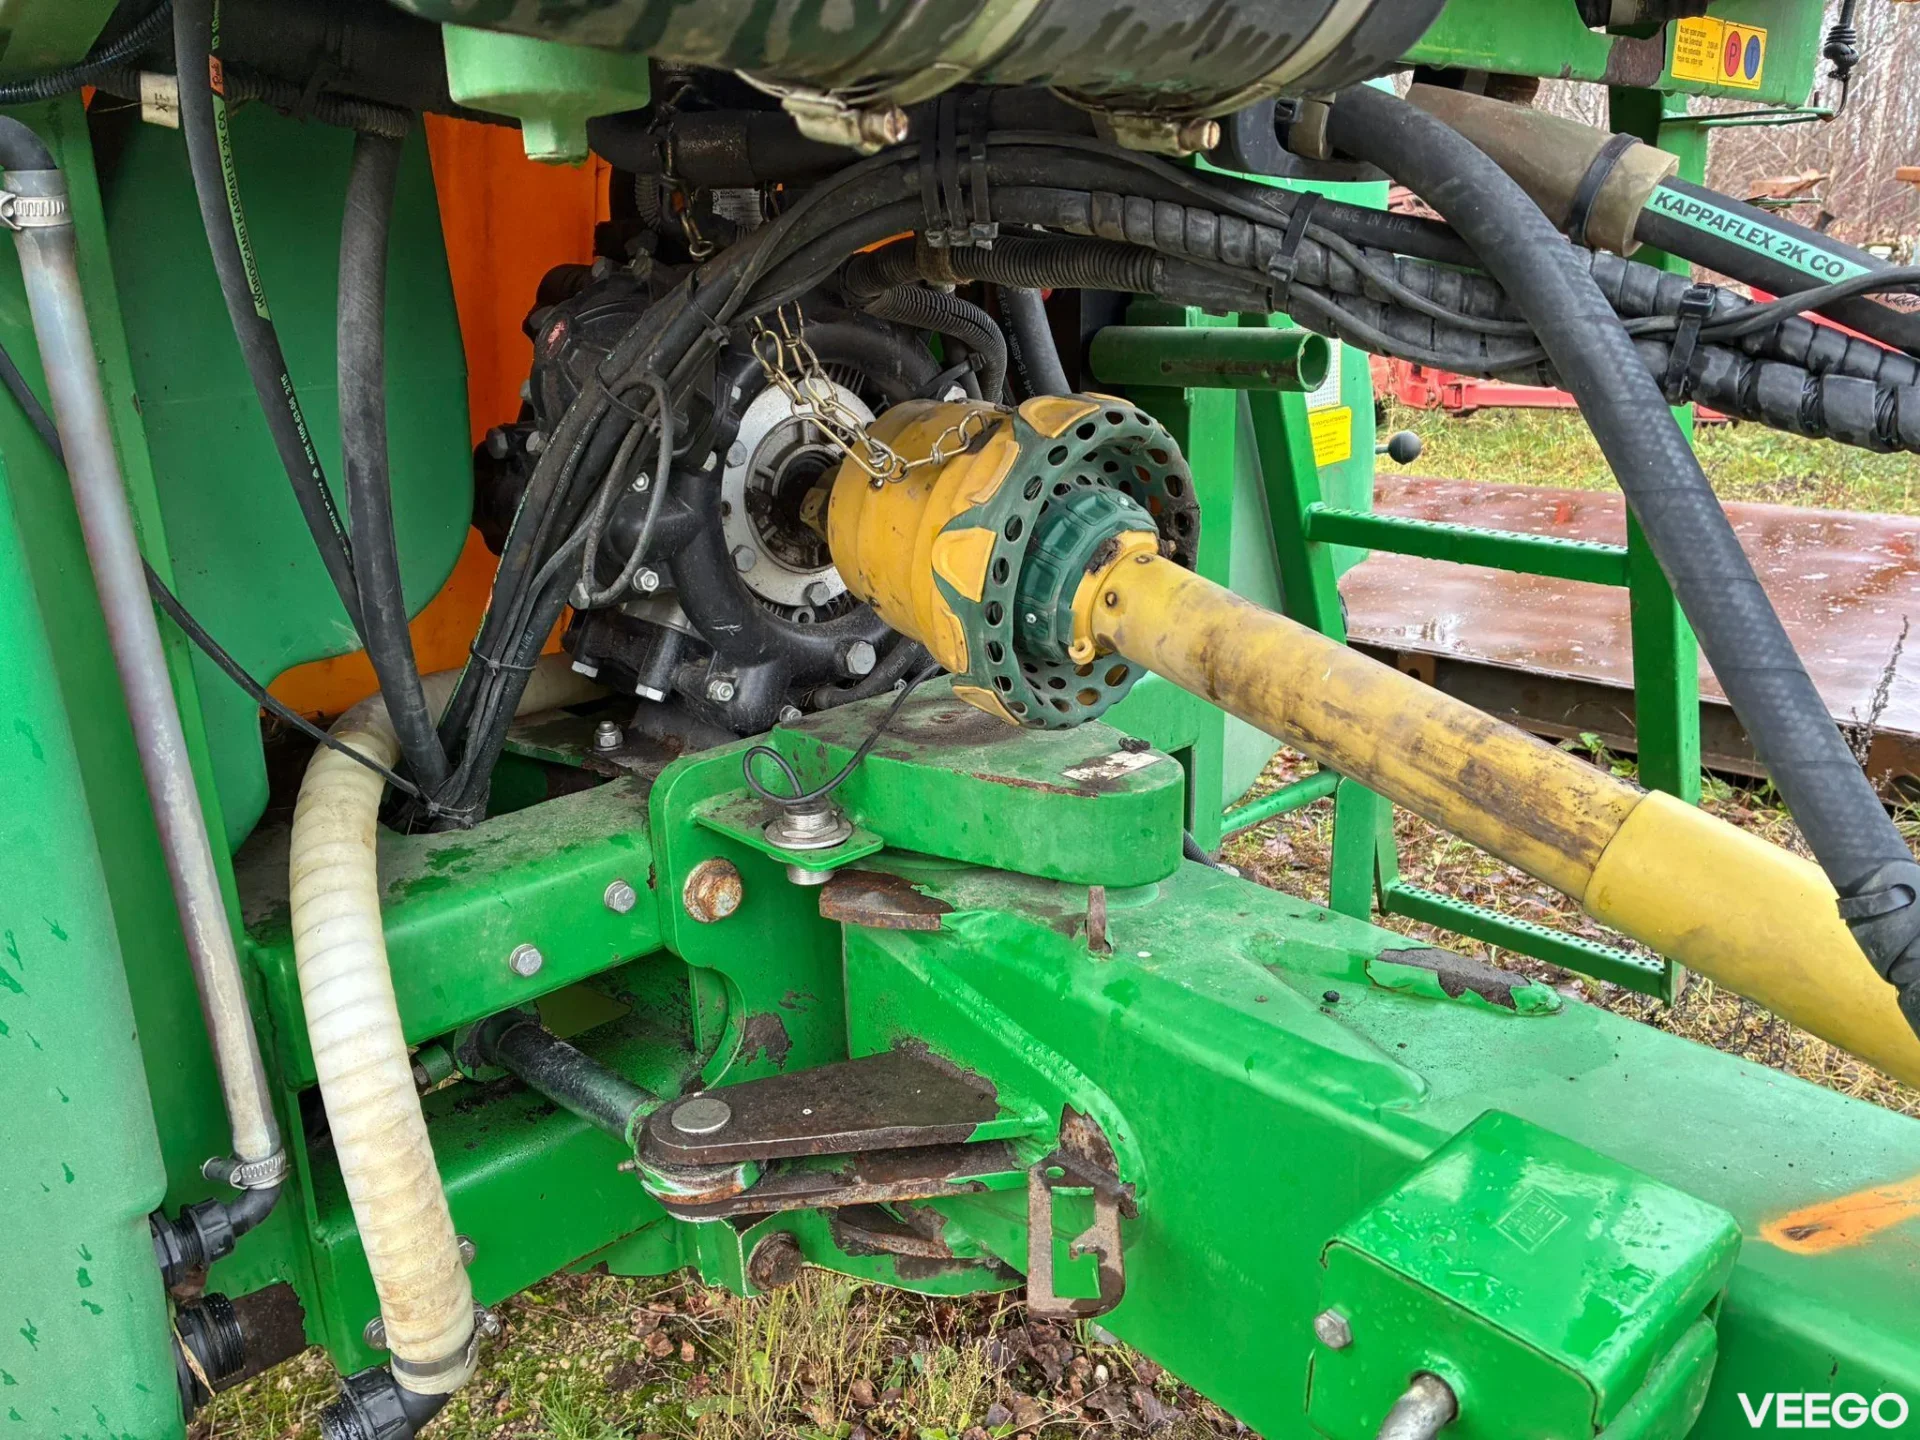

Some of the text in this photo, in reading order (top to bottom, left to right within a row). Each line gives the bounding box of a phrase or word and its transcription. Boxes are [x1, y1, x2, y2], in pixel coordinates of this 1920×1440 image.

[1728, 42, 1738, 67] P
[217, 110, 227, 130] CO
[224, 153, 246, 224] KAPPAFLEX
[1331, 206, 1359, 223] MADE
[1367, 213, 1382, 226] IN
[1654, 191, 1845, 278] KAPPAFLEX 2K CO
[238, 226, 265, 309] HYDROSCAND
